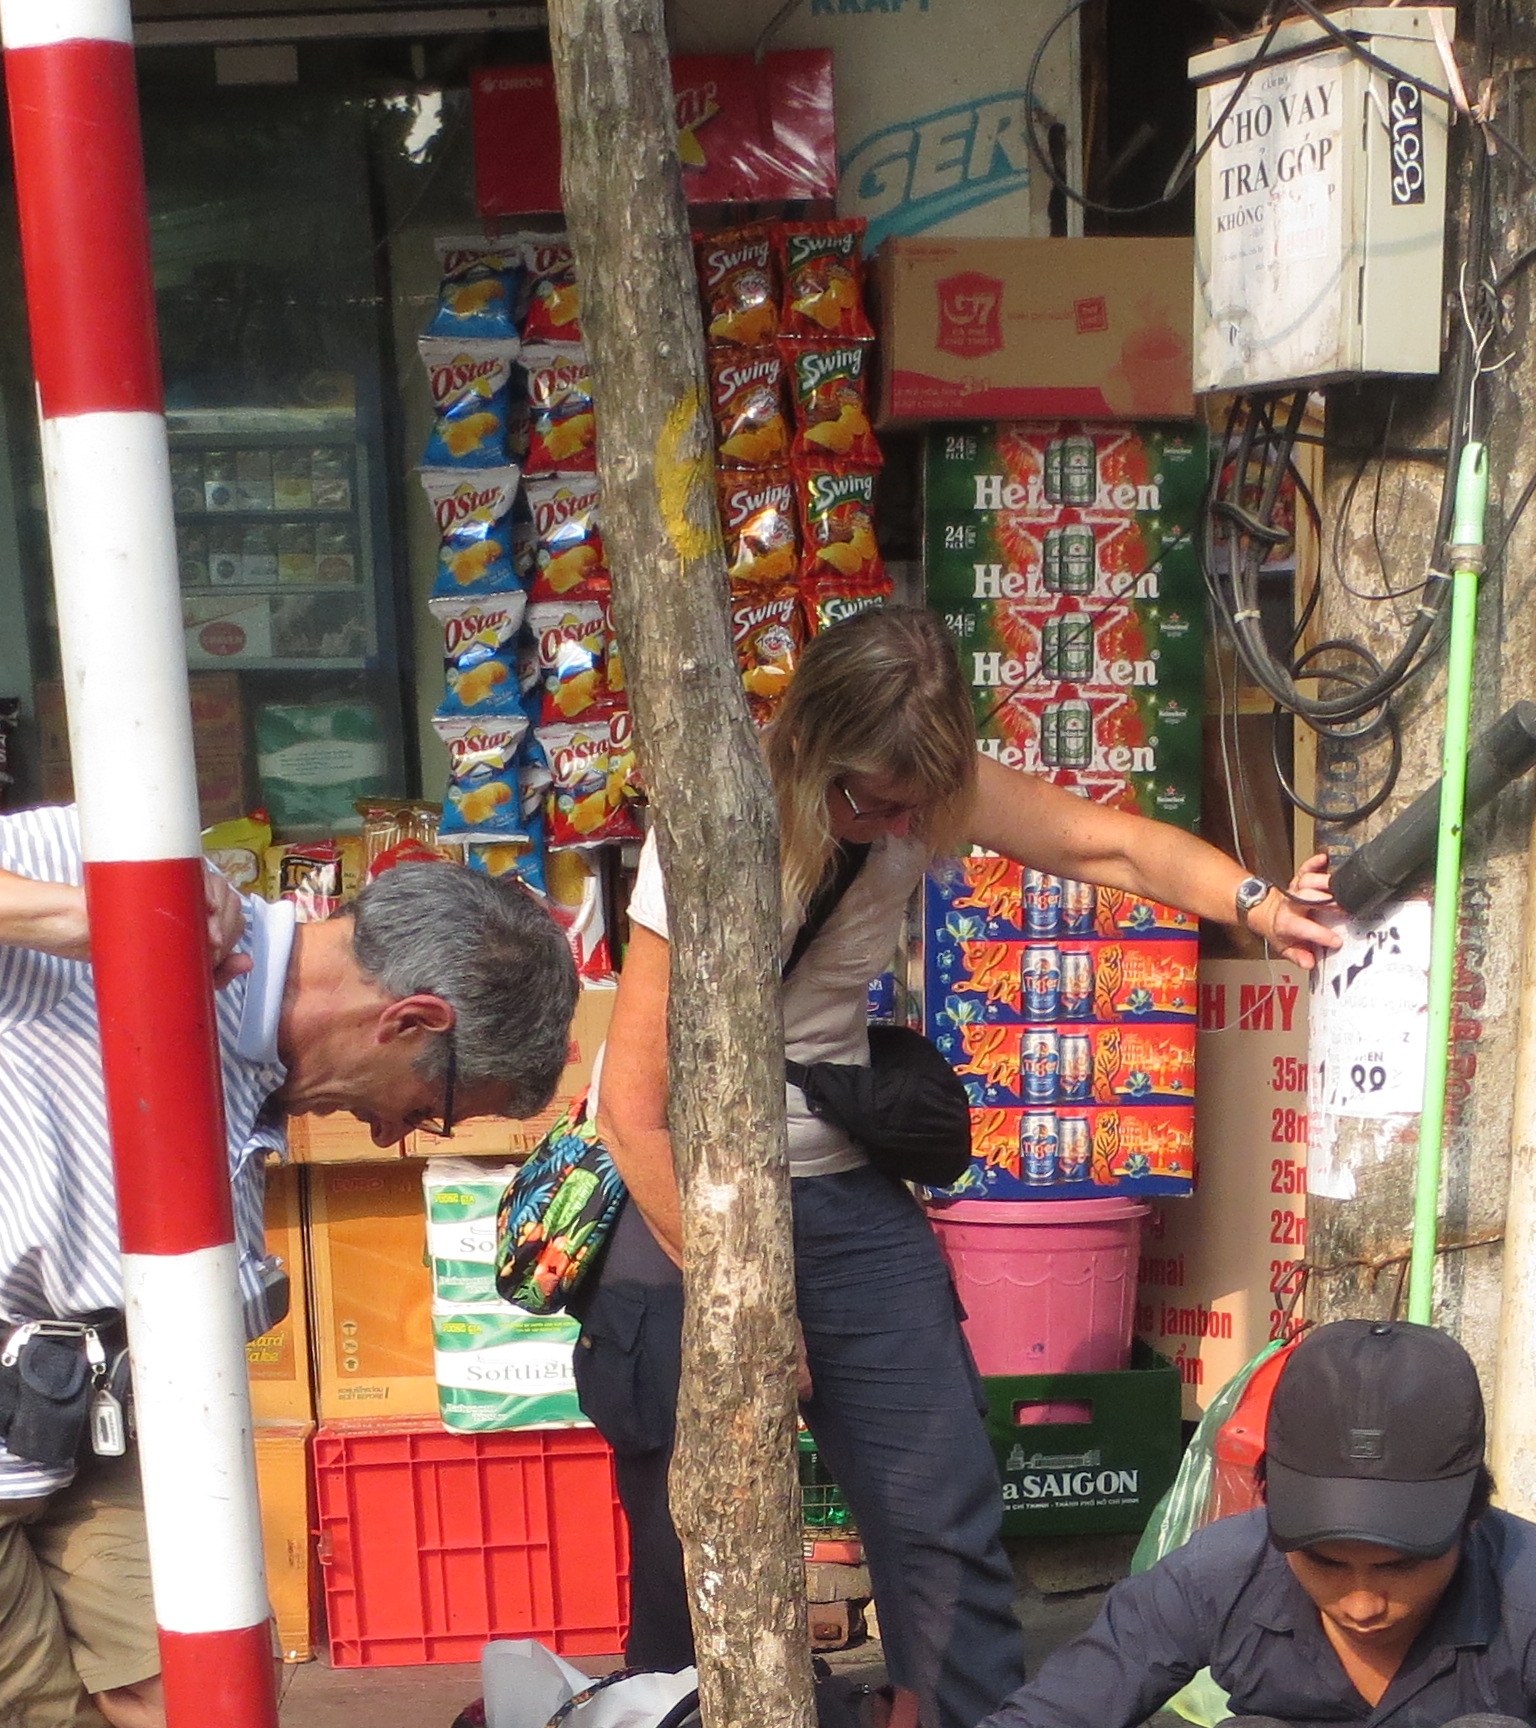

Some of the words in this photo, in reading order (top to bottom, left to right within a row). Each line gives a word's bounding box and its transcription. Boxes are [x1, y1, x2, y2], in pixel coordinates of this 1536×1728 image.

[1217, 104, 1273, 149] CHO
[1279, 80, 1336, 128] VAY
[1220, 147, 1269, 201] TRẢ
[1216, 204, 1264, 234] KHÔNG
[708, 240, 769, 287] Swing
[717, 356, 782, 406] Swing
[801, 344, 863, 390] Swing
[945, 436, 965, 453] 24
[729, 480, 792, 529] Swing
[815, 472, 874, 512] Swing
[945, 525, 964, 541] 24
[732, 596, 795, 643] Swing
[944, 613, 963, 628] 24
[1024, 889, 1061, 911] Tiger
[1024, 973, 1061, 994] Tiger
[1239, 975, 1300, 1032] MỲ
[1023, 1057, 1059, 1077] Tiger
[1023, 1139, 1058, 1159] Tiger
[1159, 1303, 1233, 1341] jambon
[249, 1350, 279, 1363] ake
[466, 1352, 576, 1385] Softligh
[1022, 1469, 1139, 1499] SAIGON
